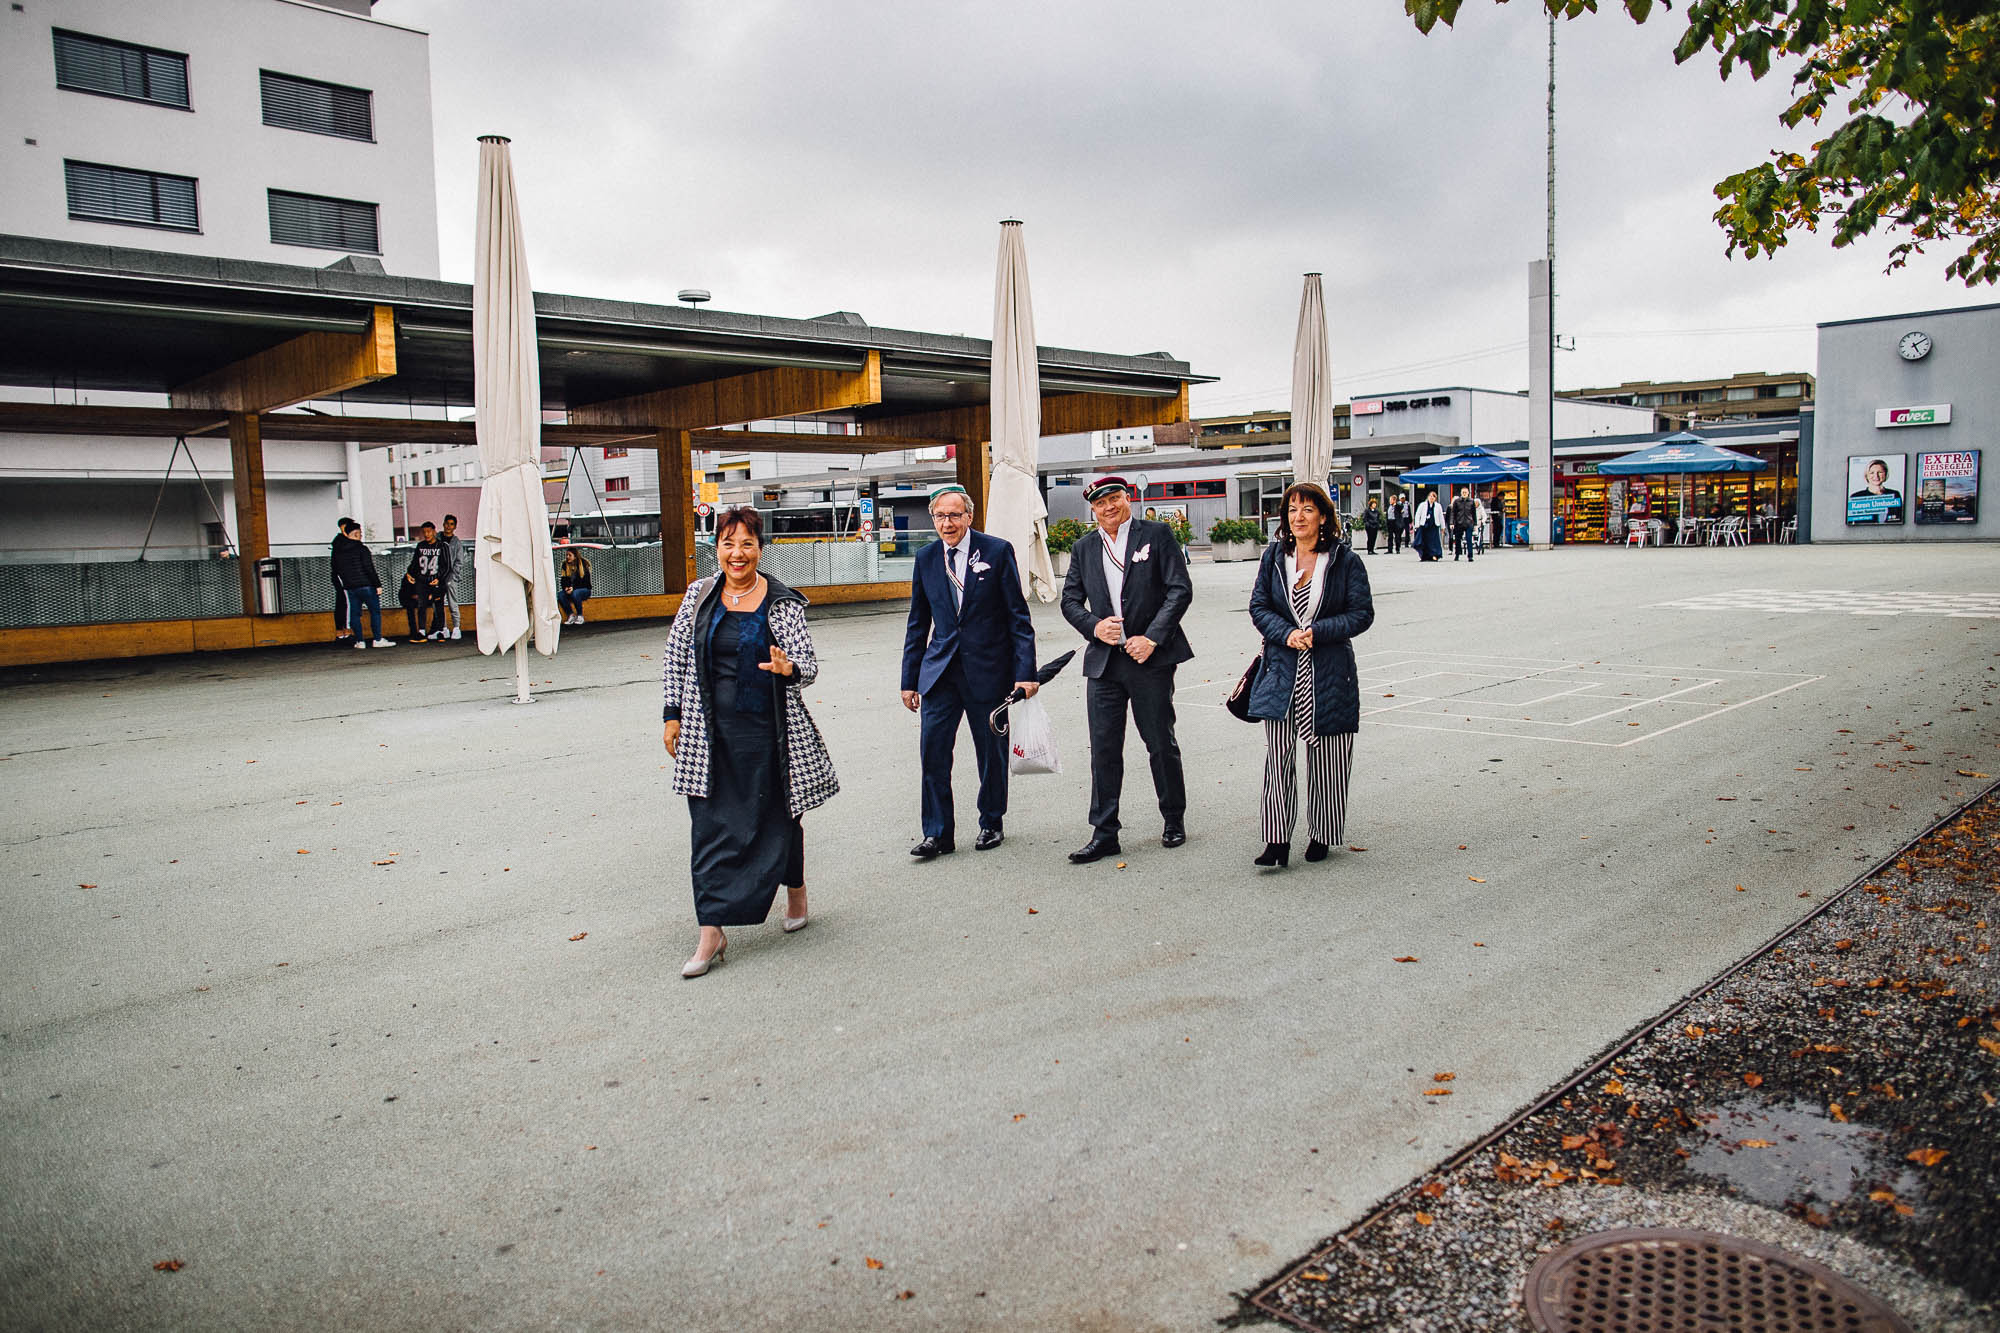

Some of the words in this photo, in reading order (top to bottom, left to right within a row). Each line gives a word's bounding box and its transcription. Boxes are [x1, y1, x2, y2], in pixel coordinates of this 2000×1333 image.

[1410, 398, 1429, 408] CFF
[1925, 454, 1973, 465] EXTRA
[1924, 463, 1973, 471] REISEGELD
[418, 556, 439, 575] 94
